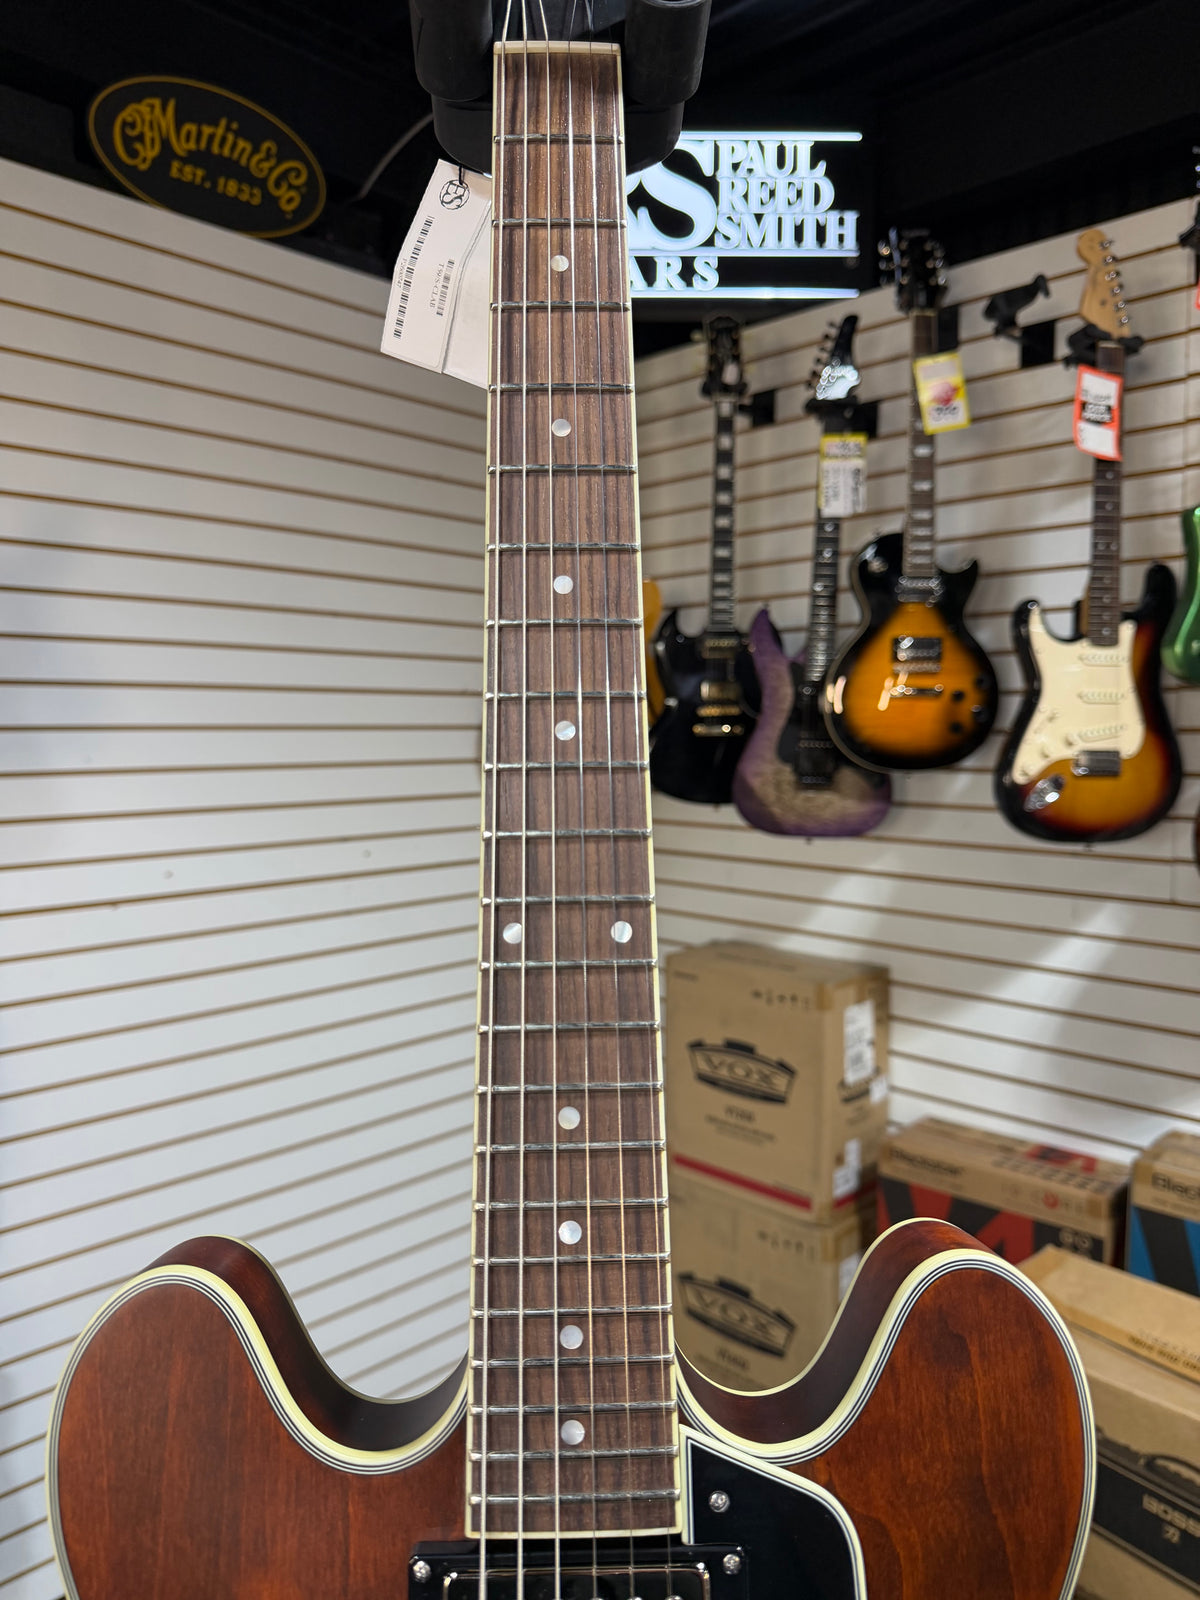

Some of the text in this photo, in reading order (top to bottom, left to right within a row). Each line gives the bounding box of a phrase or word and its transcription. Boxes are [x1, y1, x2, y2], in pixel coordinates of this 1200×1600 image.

[169, 159, 212, 189] EST.
[716, 140, 827, 178] PAUL
[717, 176, 835, 214] REED
[715, 211, 860, 250] SMITH
[629, 256, 720, 291] ARS
[701, 1051, 779, 1088] VOX
[696, 1291, 779, 1338] VOX
